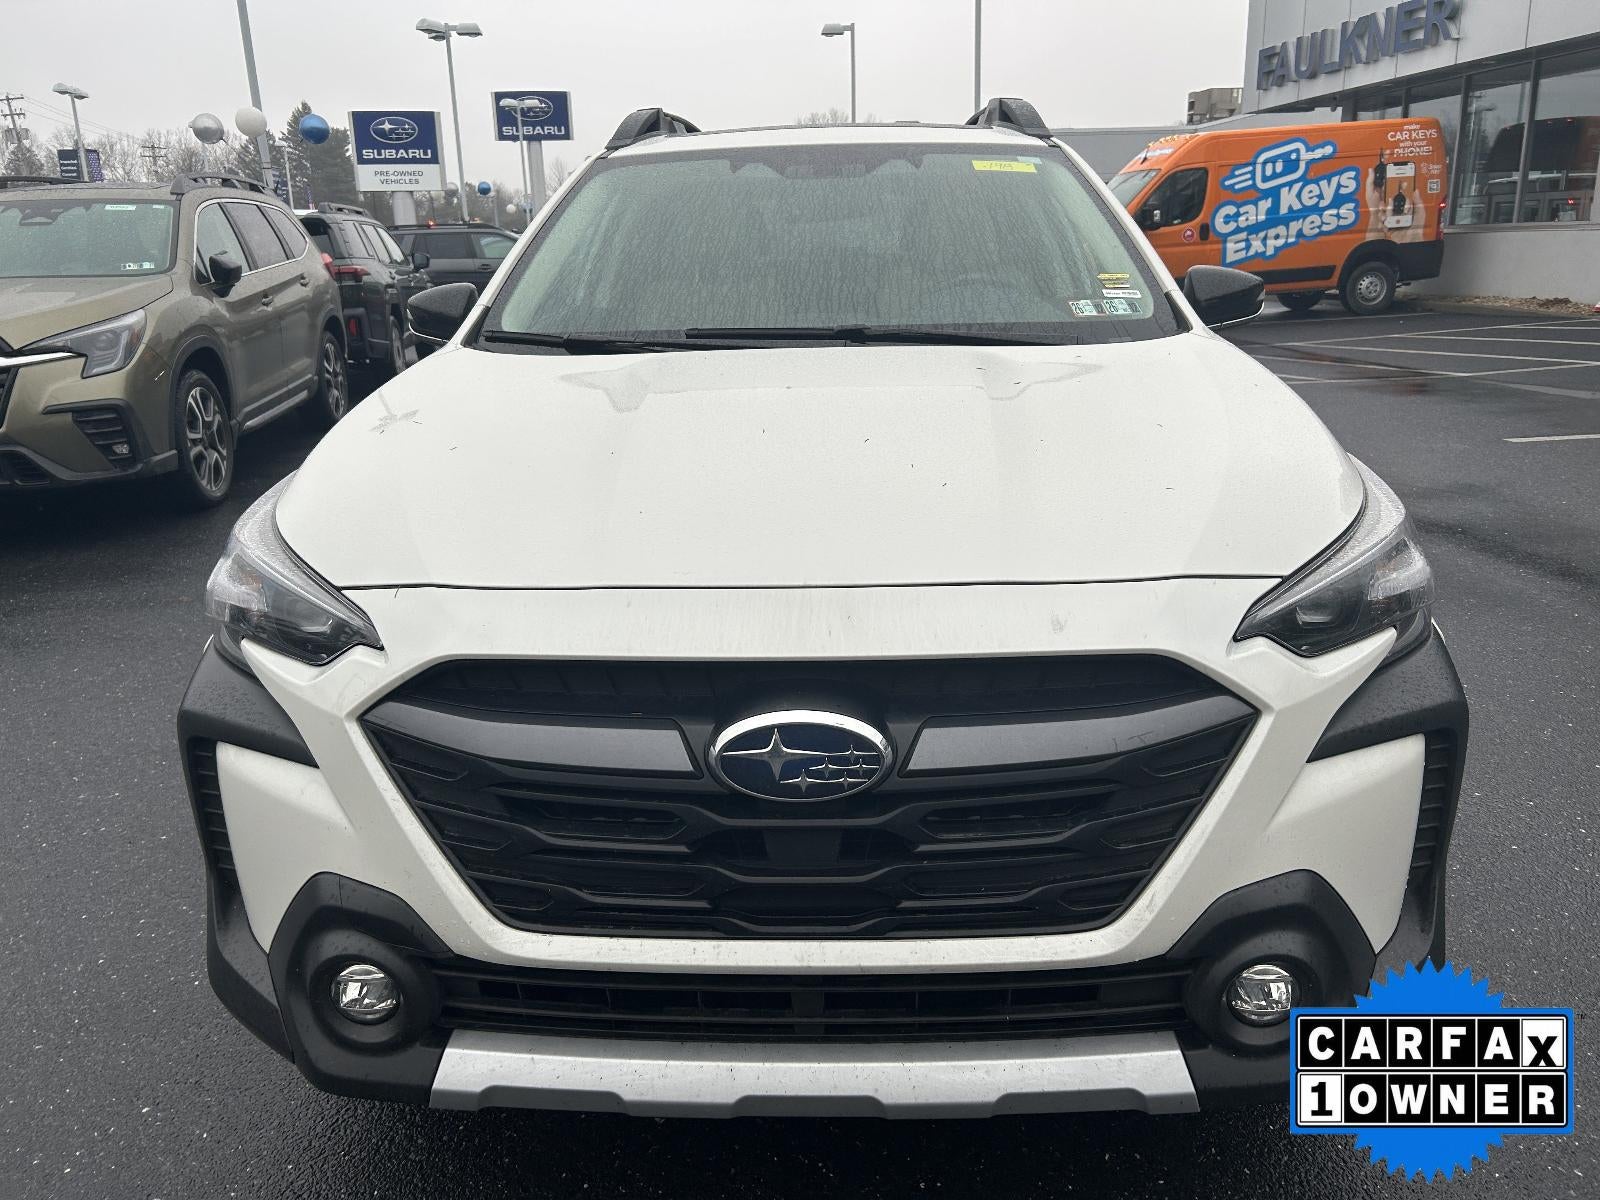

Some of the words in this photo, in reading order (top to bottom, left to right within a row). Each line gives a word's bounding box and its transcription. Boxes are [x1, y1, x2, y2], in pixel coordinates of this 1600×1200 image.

[1257, 0, 1462, 90] FAULKNER
[1387, 131, 1410, 141] CAR
[1412, 129, 1438, 139] KEYS
[362, 149, 432, 159] SUBARU
[1214, 197, 1272, 234] Car
[1279, 170, 1357, 215] Keys
[1225, 202, 1356, 264] Express
[1105, 300, 1119, 313] 26
